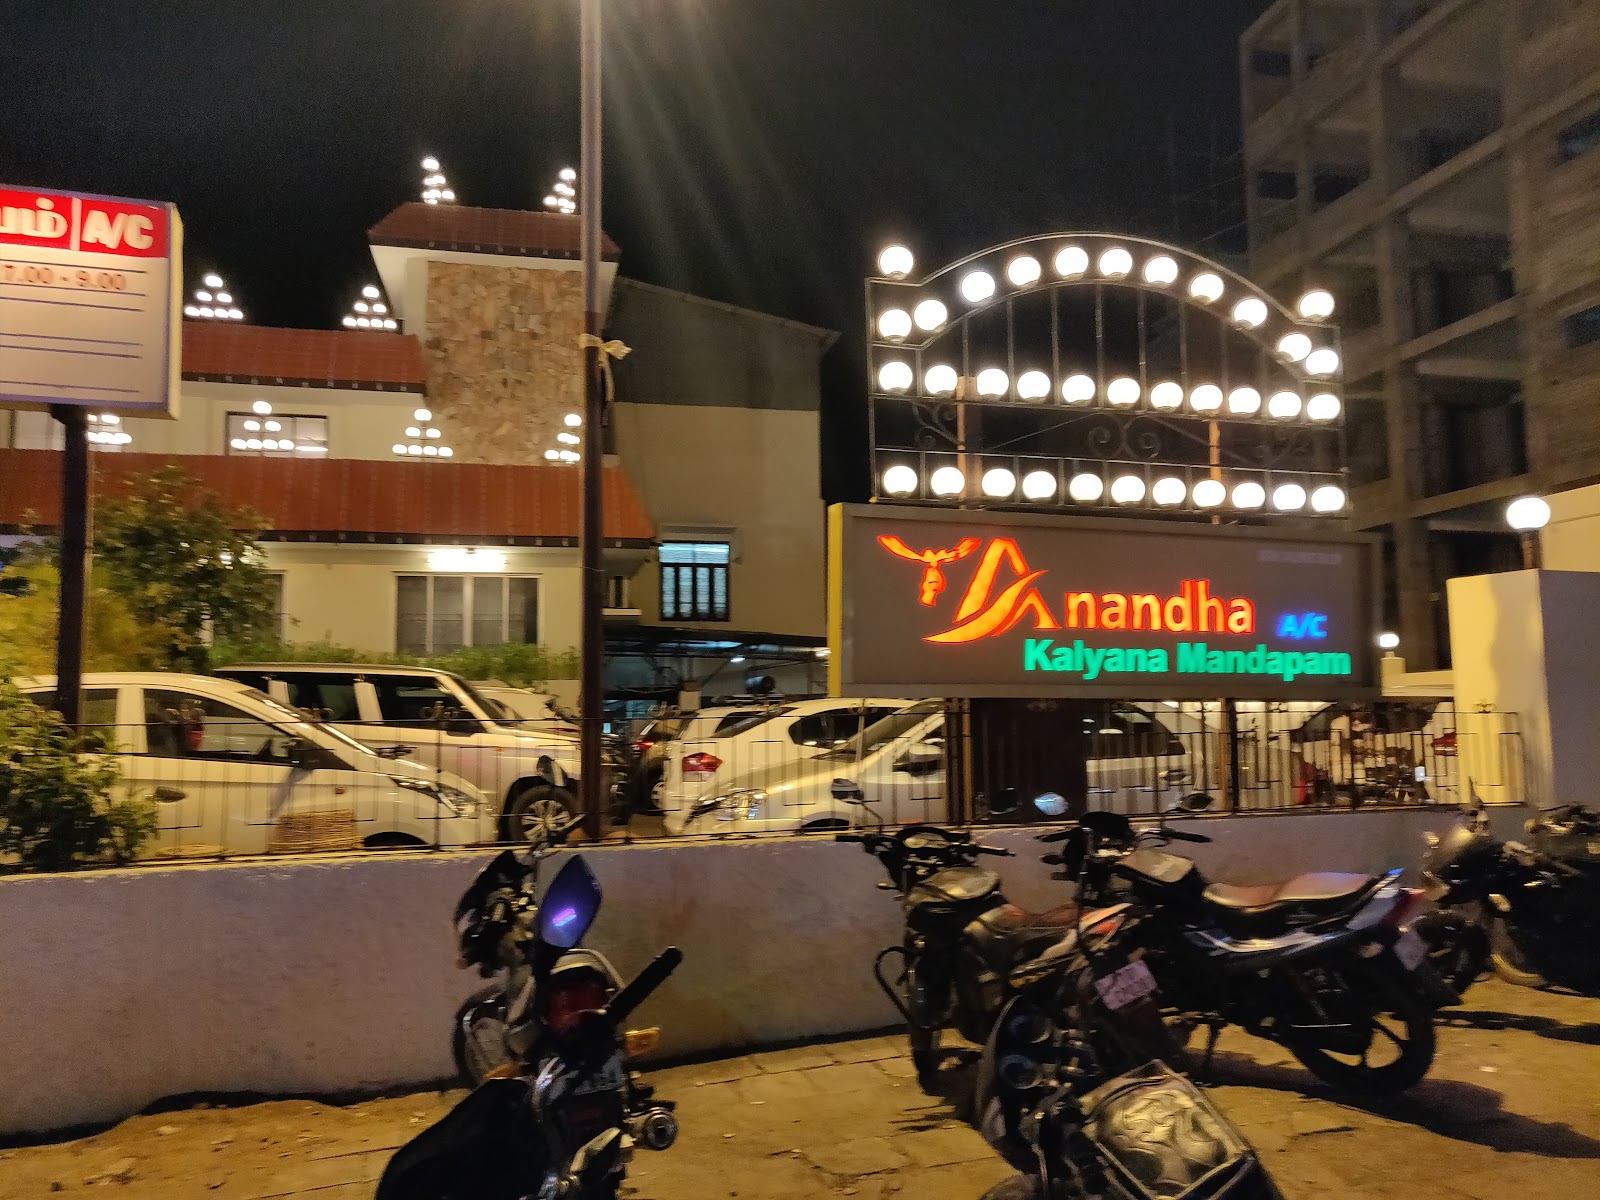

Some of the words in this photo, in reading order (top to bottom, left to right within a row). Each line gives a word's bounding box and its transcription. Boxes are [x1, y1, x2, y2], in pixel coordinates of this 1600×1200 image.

[82, 209, 154, 250] A/C
[922, 537, 1256, 645] Anandha
[1276, 612, 1329, 638] A/C
[1023, 637, 1169, 680] Kalyana
[1175, 641, 1352, 682] Mandapam
